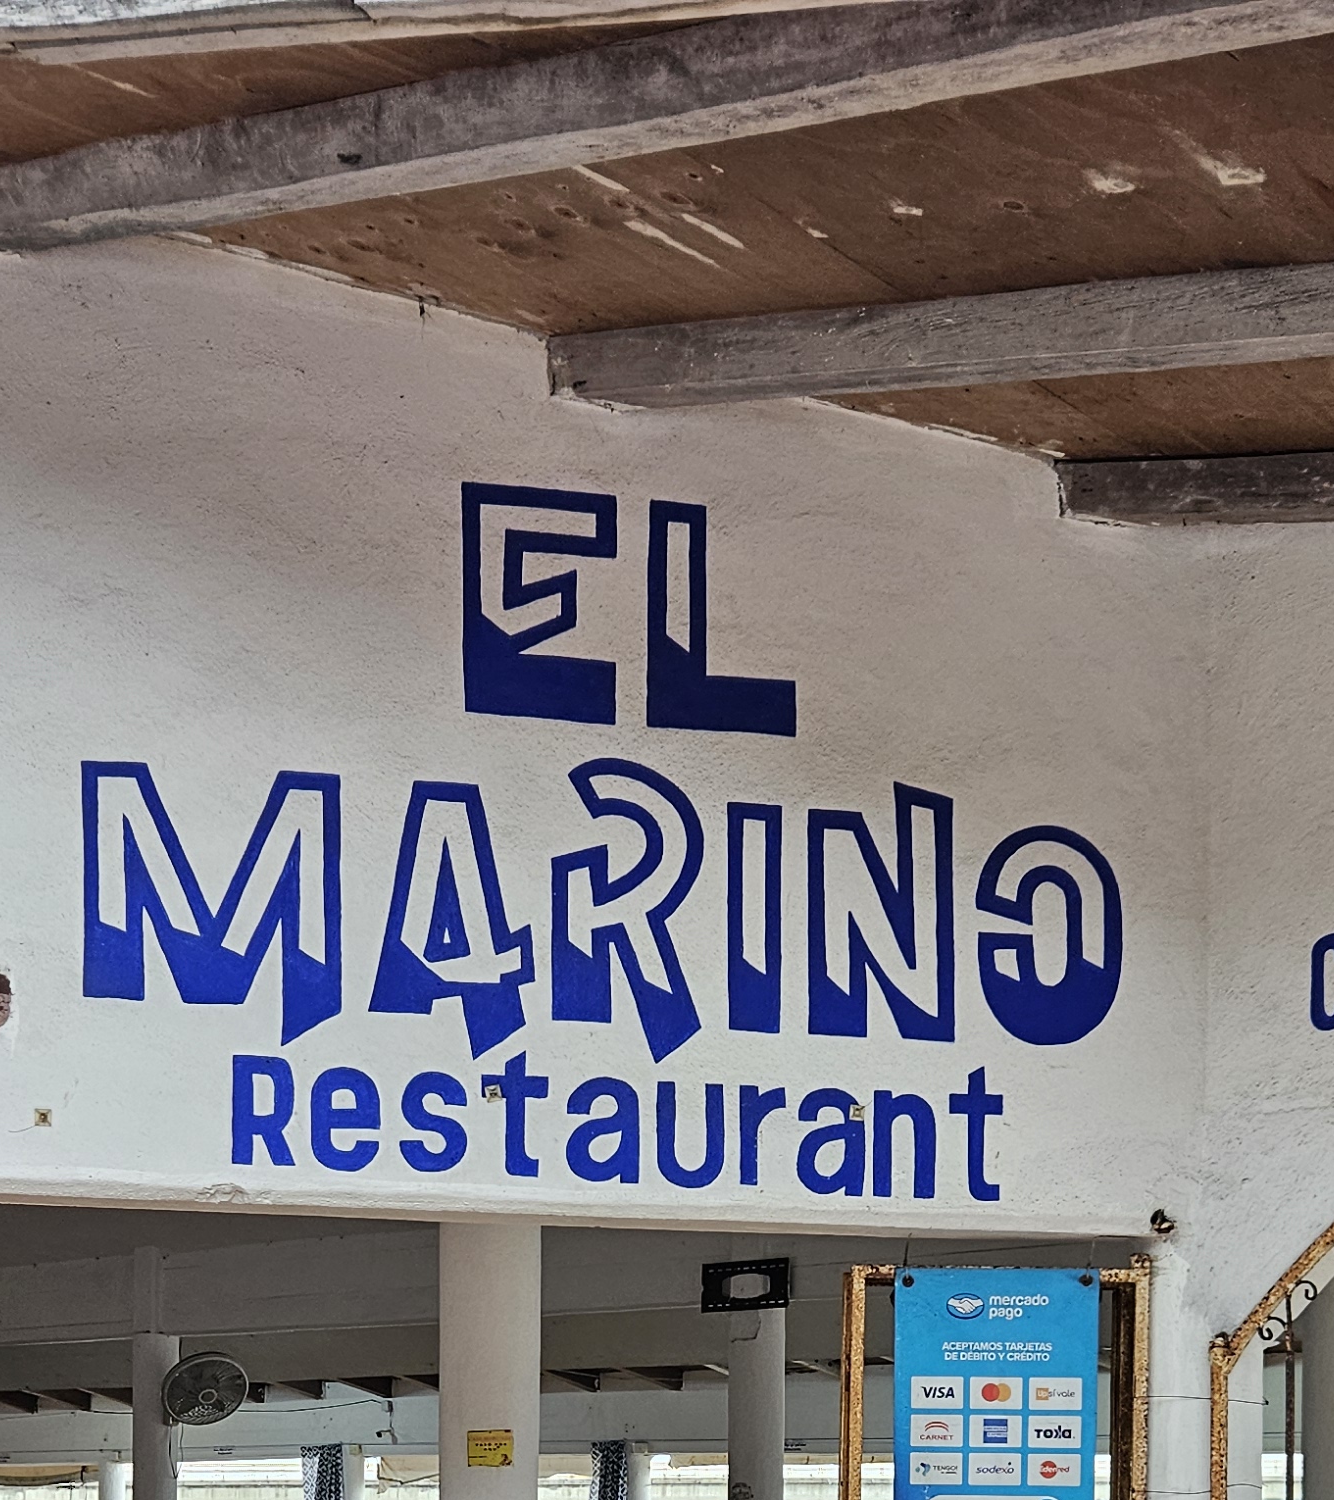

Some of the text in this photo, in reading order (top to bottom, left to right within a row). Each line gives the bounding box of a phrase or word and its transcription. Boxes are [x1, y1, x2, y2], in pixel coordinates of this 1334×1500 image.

[461, 481, 797, 737] EL
[80, 757, 1124, 1063] MARINO
[231, 1049, 1004, 1202] Restaurant
[988, 1293, 1050, 1306] mercado
[988, 1307, 1023, 1320] pago
[941, 1341, 1053, 1351] ACEPTAMOS TARJETAS
[944, 1351, 1050, 1362] DE DÉBITO Y CRÉDITO
[920, 1386, 955, 1399] VISA
[975, 1462, 1015, 1475] sodexo
